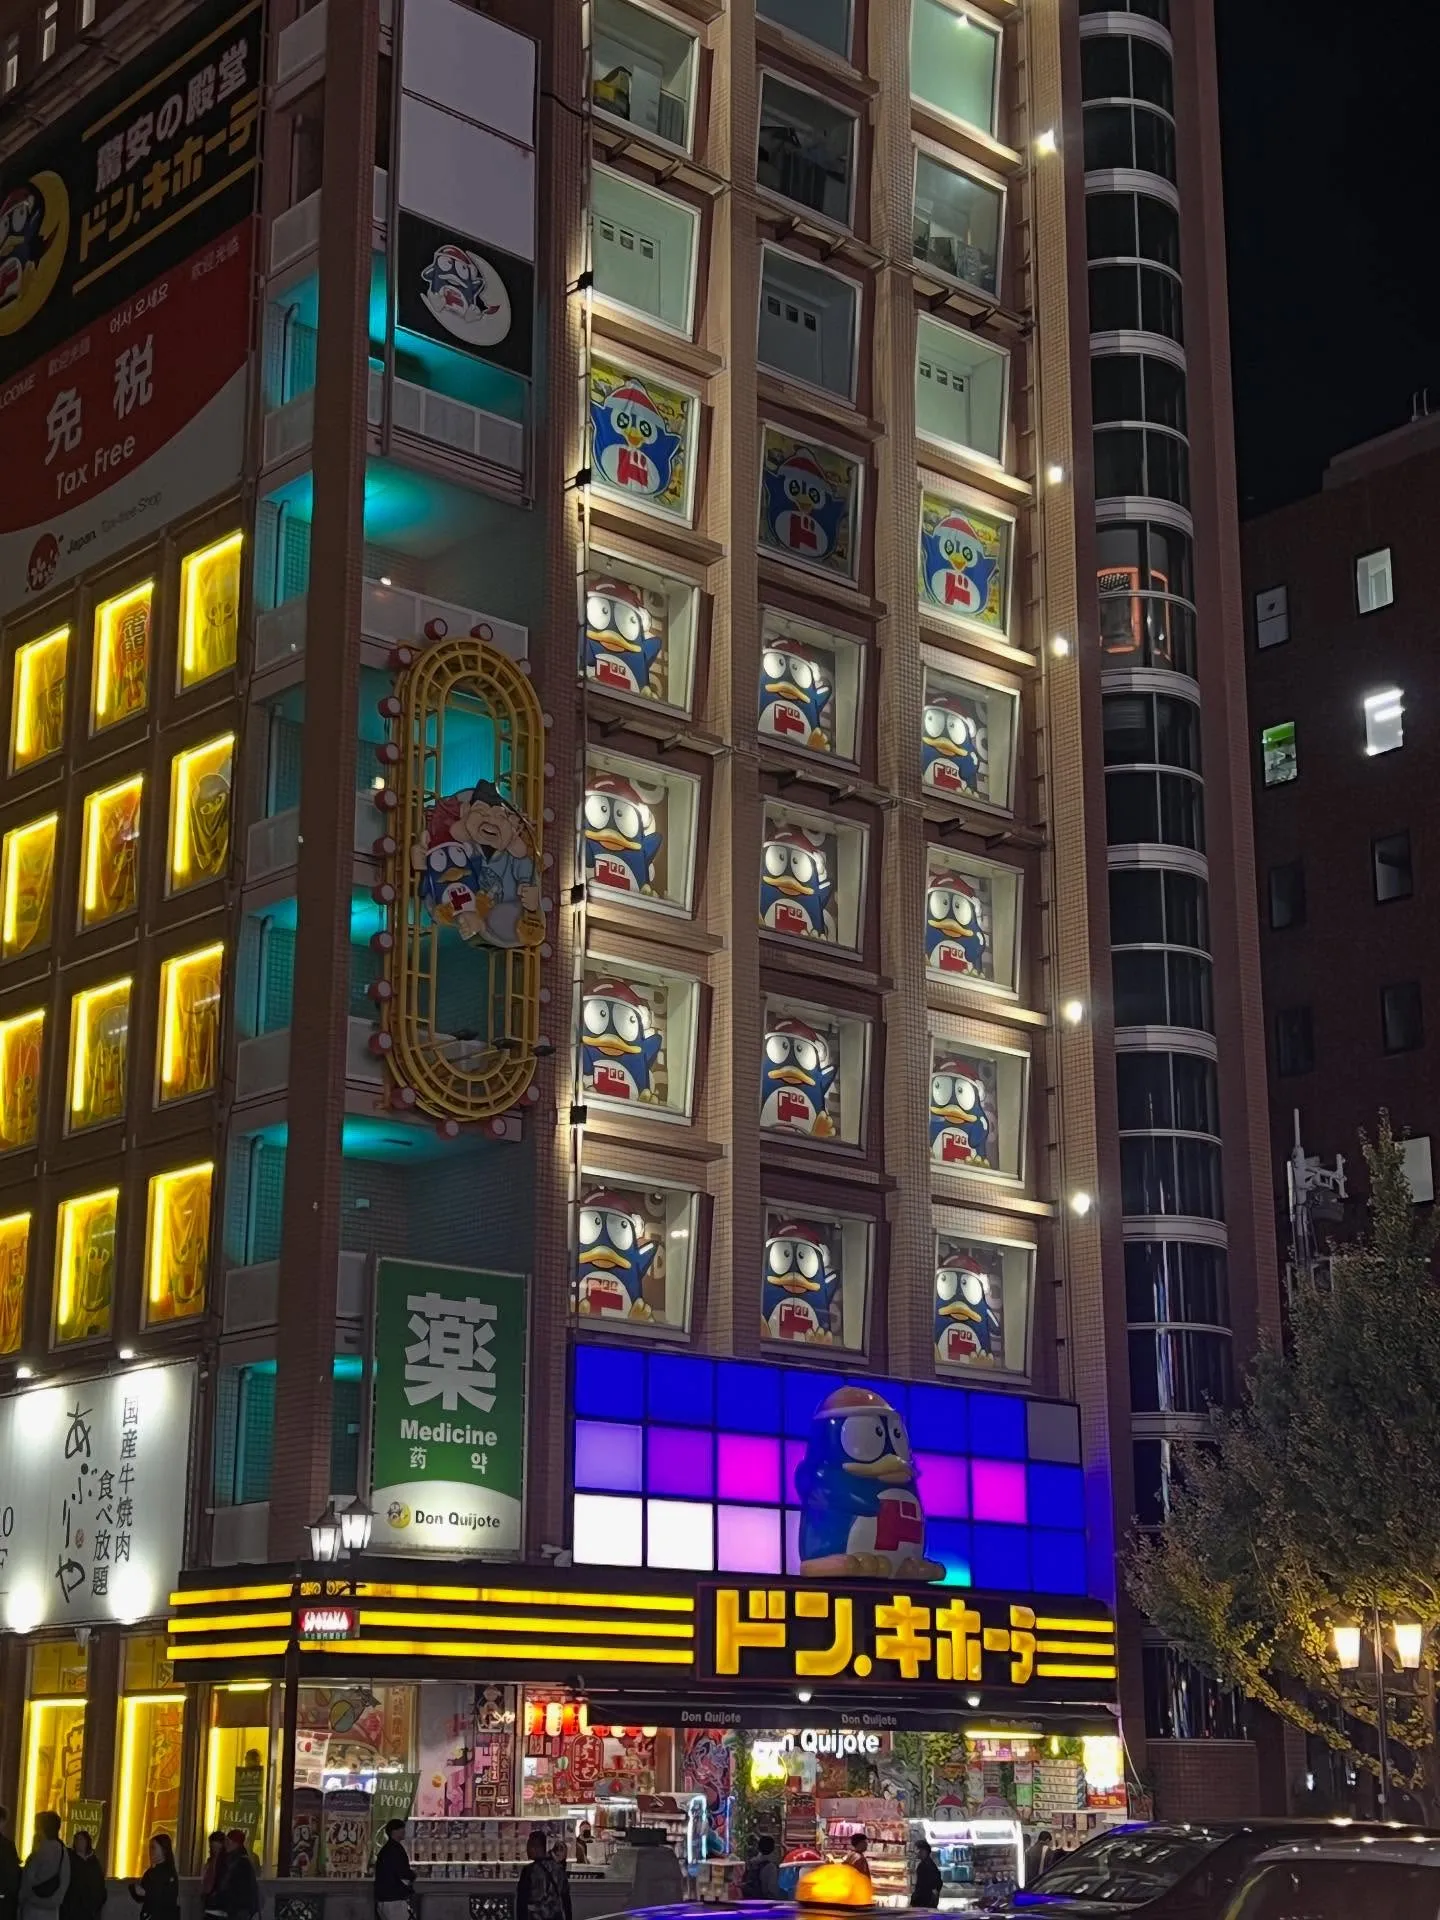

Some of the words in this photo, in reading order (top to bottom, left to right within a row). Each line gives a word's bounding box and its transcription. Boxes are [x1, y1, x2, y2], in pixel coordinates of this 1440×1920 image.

[56, 462, 88, 501] Tax
[94, 434, 137, 479] Free
[403, 1291, 498, 1414] 薬
[400, 1418, 498, 1447] Medicine
[470, 1451, 489, 1475] 약
[415, 1509, 444, 1525] Don
[448, 1511, 501, 1530] Quijote
[681, 1710, 702, 1723] Don
[703, 1711, 742, 1724] Quijote
[841, 1713, 861, 1725] Don
[862, 1714, 898, 1727] Quijote
[800, 1729, 880, 1758] Quijote
